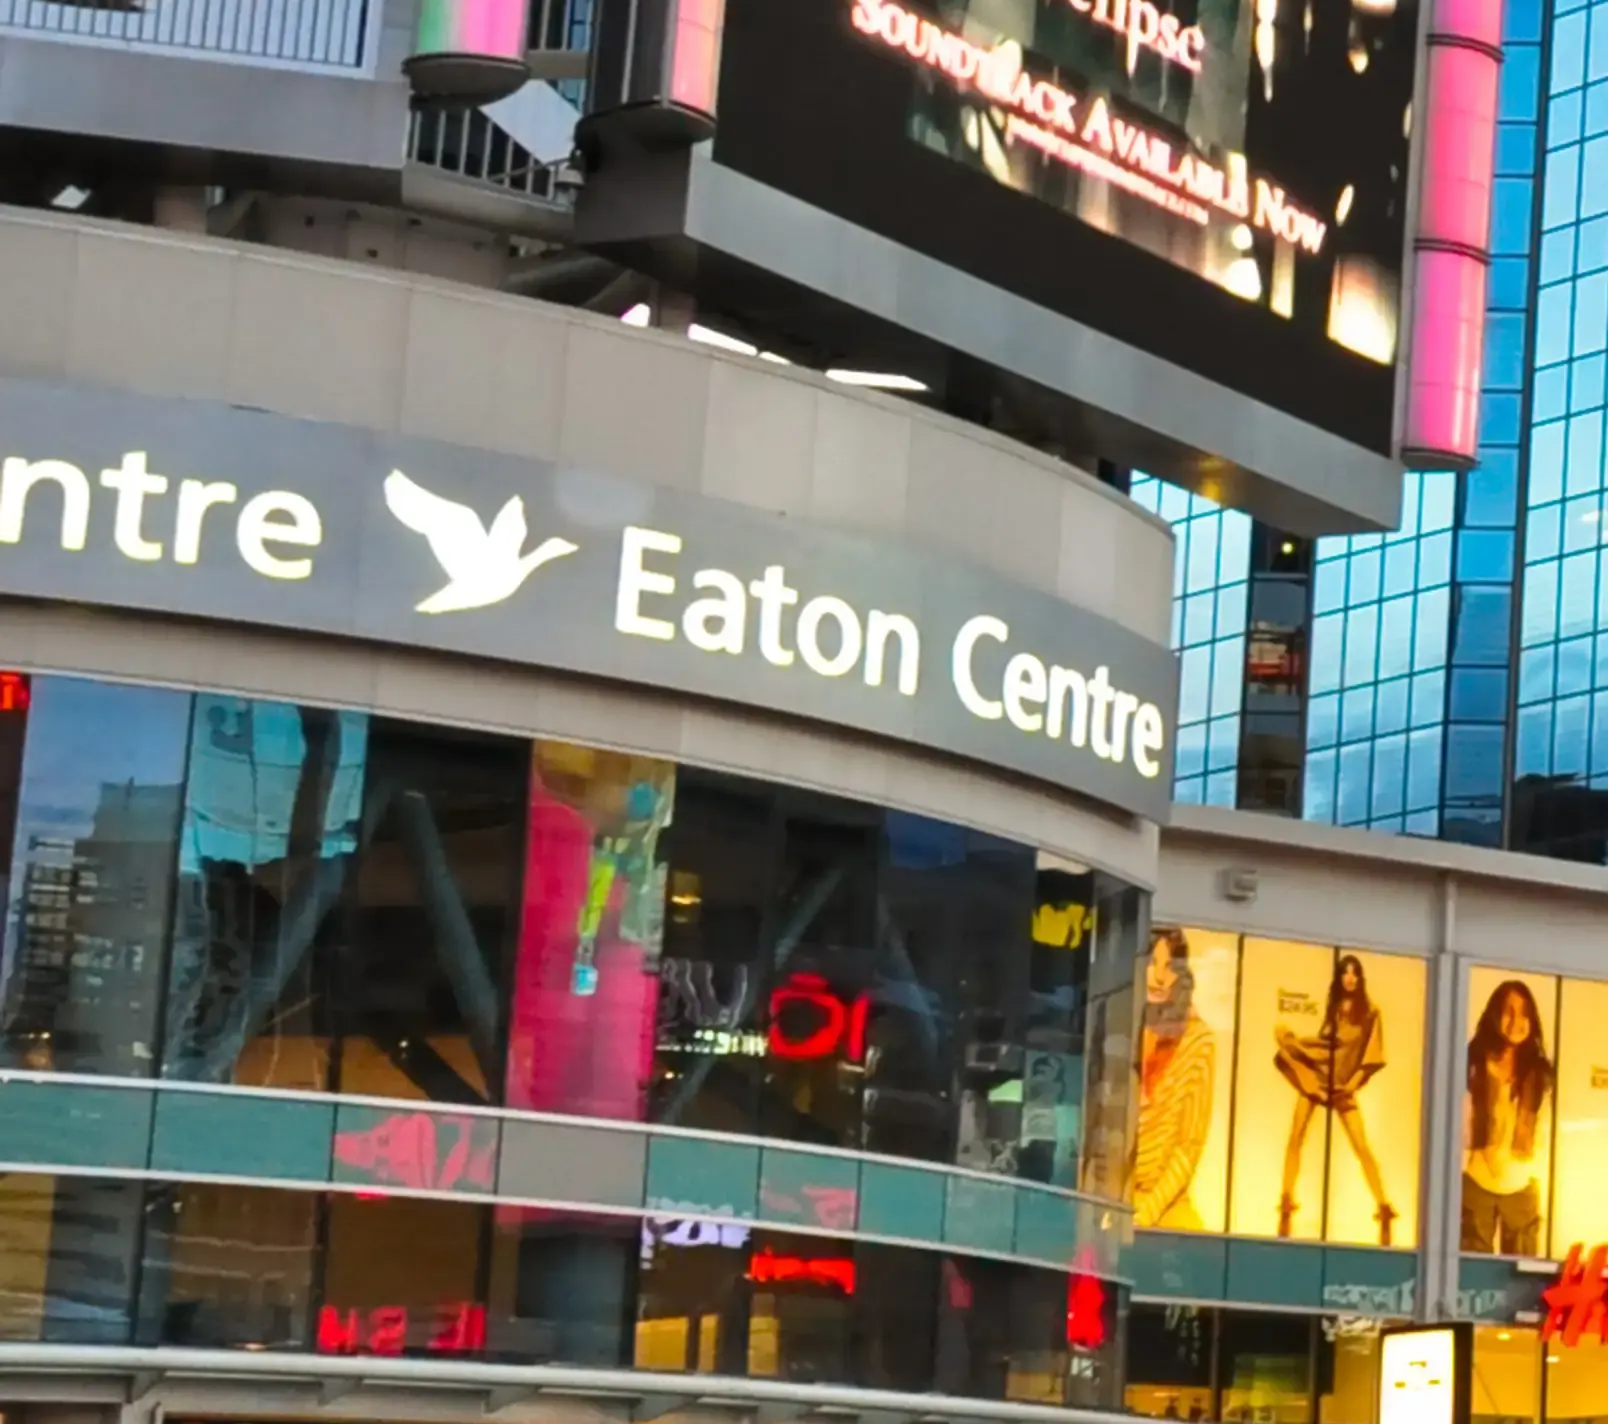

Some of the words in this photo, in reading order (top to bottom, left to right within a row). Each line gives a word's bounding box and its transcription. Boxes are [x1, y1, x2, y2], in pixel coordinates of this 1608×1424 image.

[0, 449, 324, 580] ntre
[614, 525, 921, 697] Eaton
[951, 612, 1166, 779] Centre
